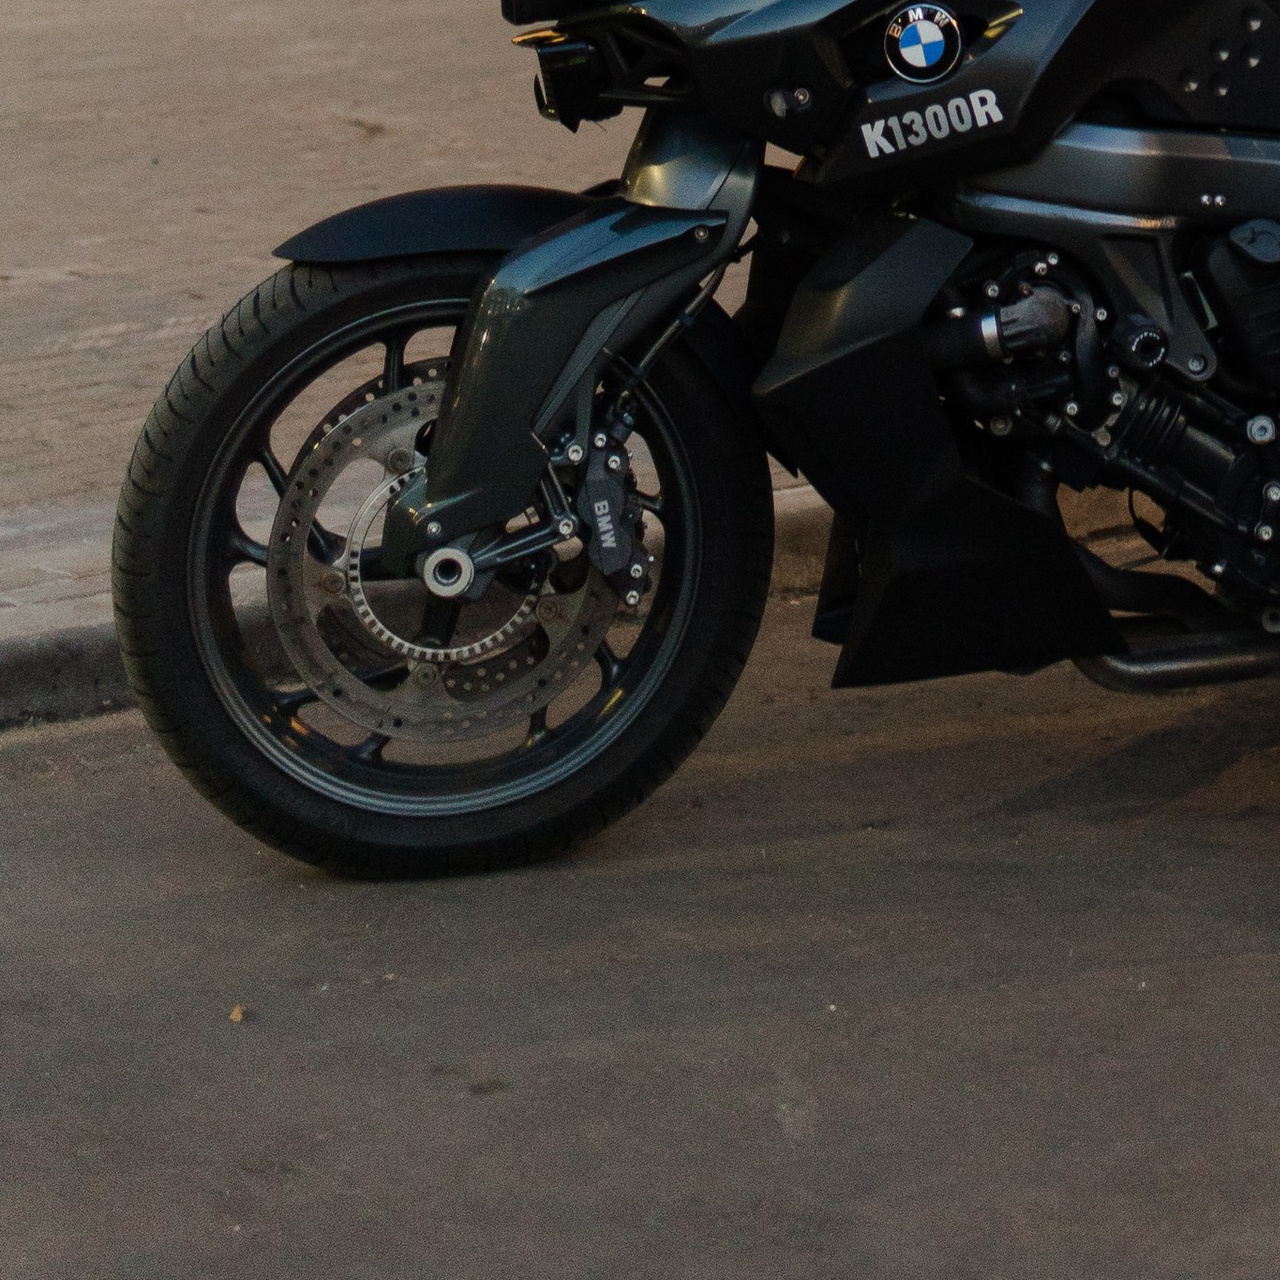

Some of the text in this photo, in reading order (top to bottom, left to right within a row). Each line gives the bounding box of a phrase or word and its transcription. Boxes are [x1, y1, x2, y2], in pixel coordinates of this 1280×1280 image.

[888, 7, 950, 39] BMW
[860, 88, 1004, 159] K1300R
[594, 499, 617, 549] BMW
